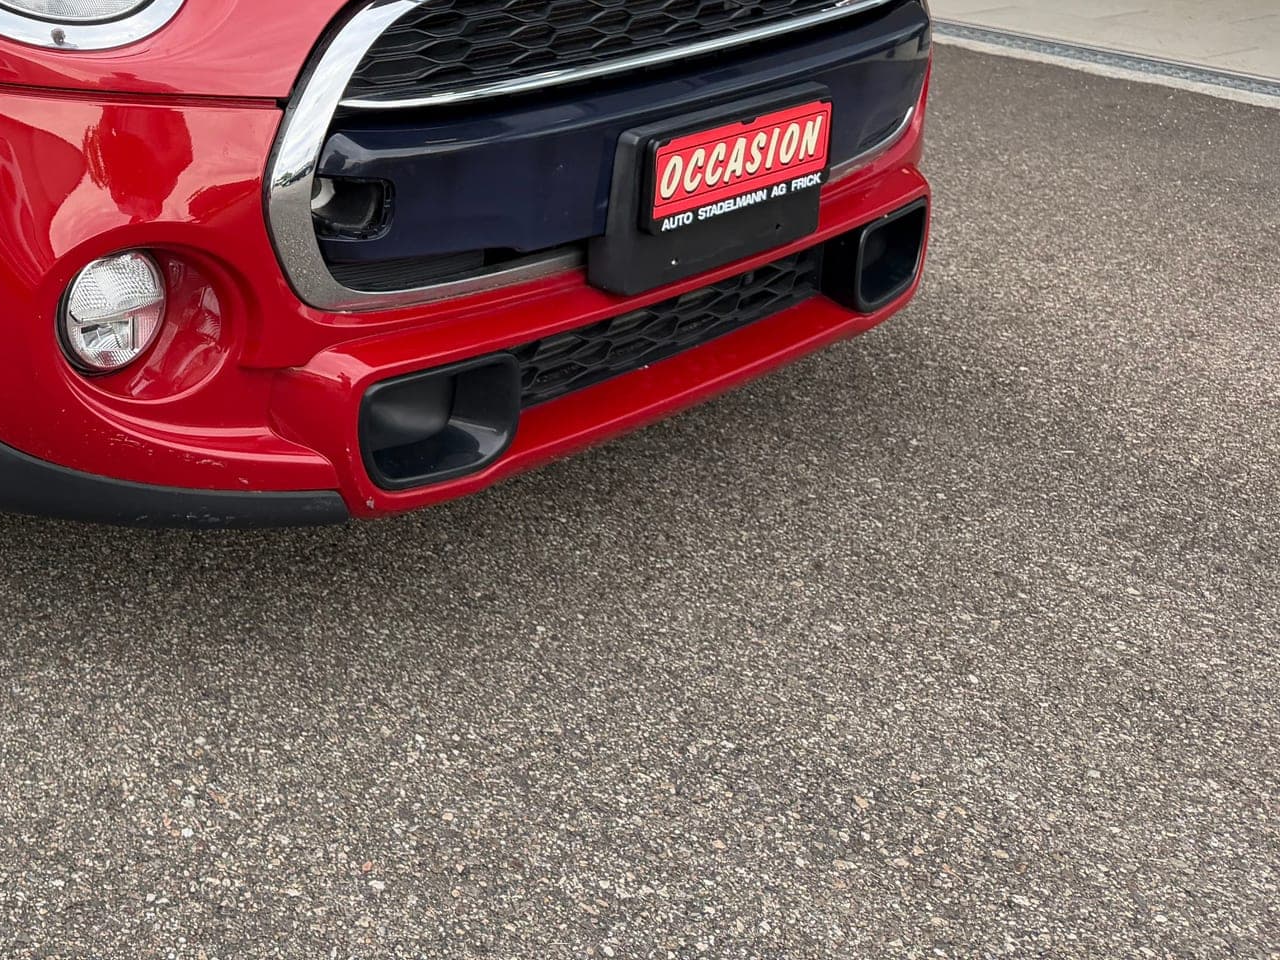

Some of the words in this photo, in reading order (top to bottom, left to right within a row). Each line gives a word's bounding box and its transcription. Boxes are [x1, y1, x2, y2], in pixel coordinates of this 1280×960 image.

[660, 115, 823, 199] OCCASION
[661, 212, 693, 231] AUTO
[698, 189, 767, 220] STADELMANN
[771, 183, 787, 198] AG
[791, 172, 822, 191] FRICK
